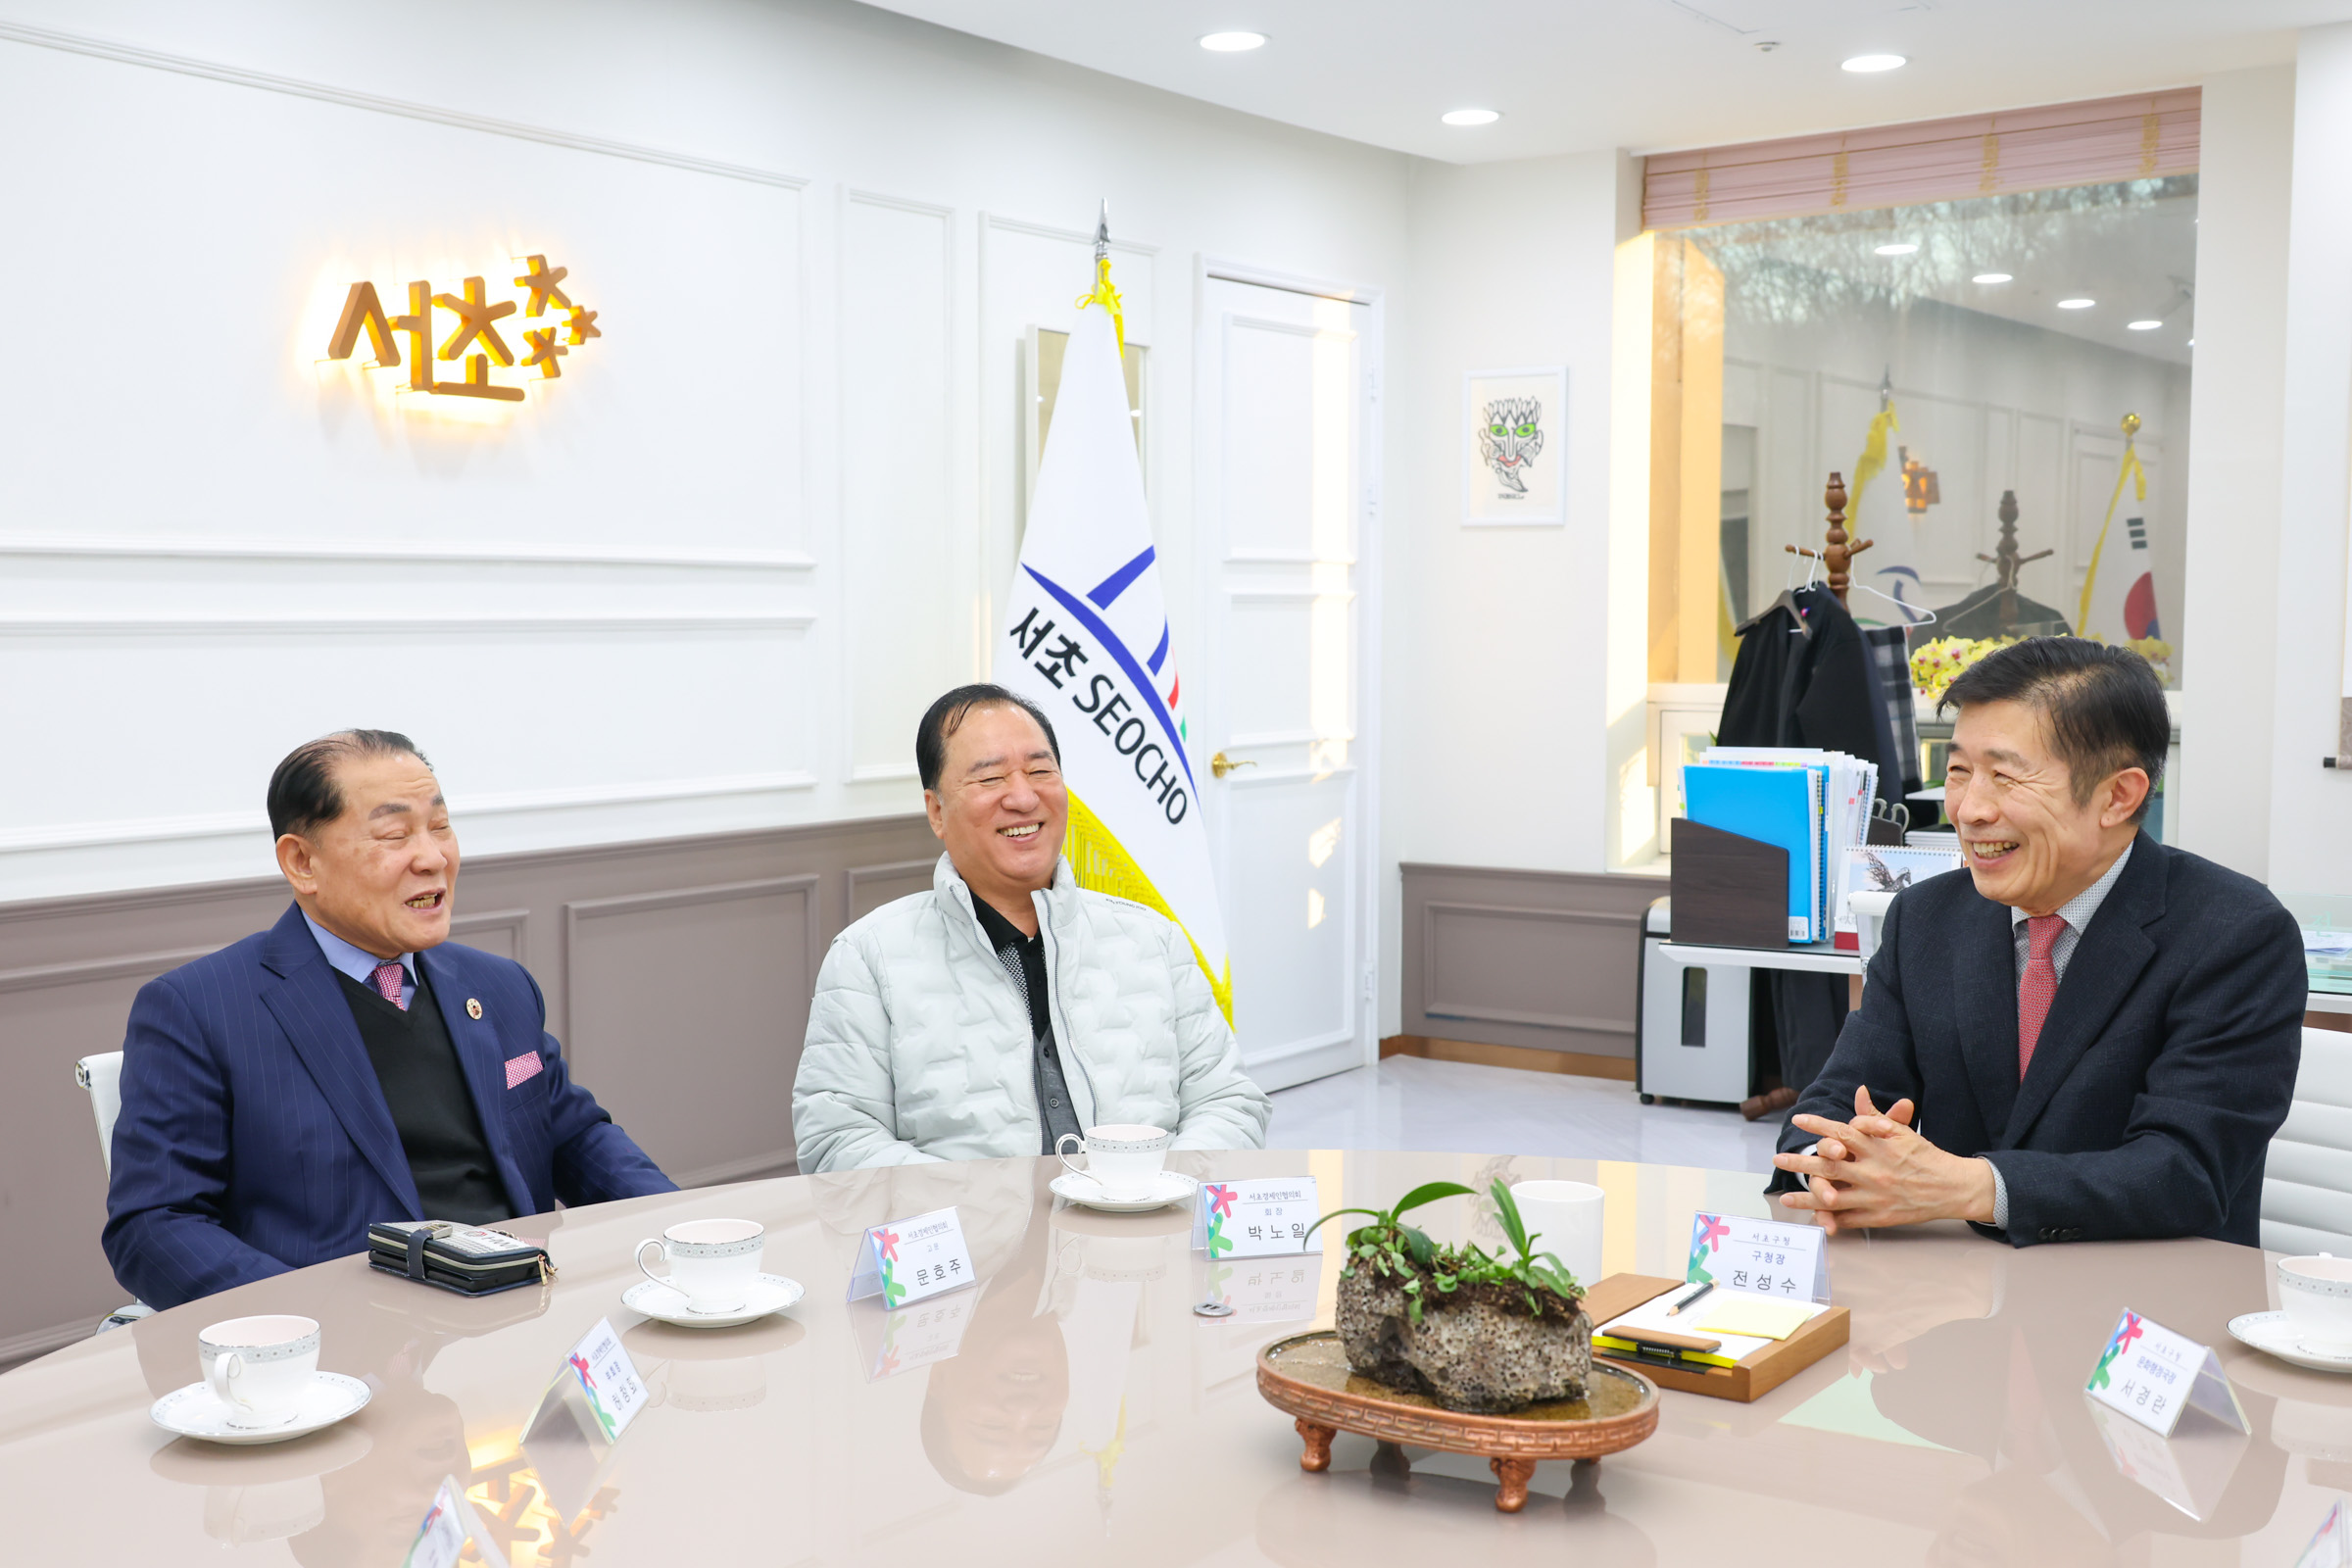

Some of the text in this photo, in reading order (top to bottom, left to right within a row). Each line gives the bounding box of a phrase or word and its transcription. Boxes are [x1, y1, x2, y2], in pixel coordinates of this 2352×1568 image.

[1009, 607, 1188, 825] 서초 SEOCHO
[1248, 1223, 1304, 1241] 박노일
[1751, 1232, 1791, 1247] 서초구청
[1751, 1250, 1786, 1266] 구청장
[916, 1258, 961, 1287] 문호주
[1732, 1269, 1796, 1294] 전성수
